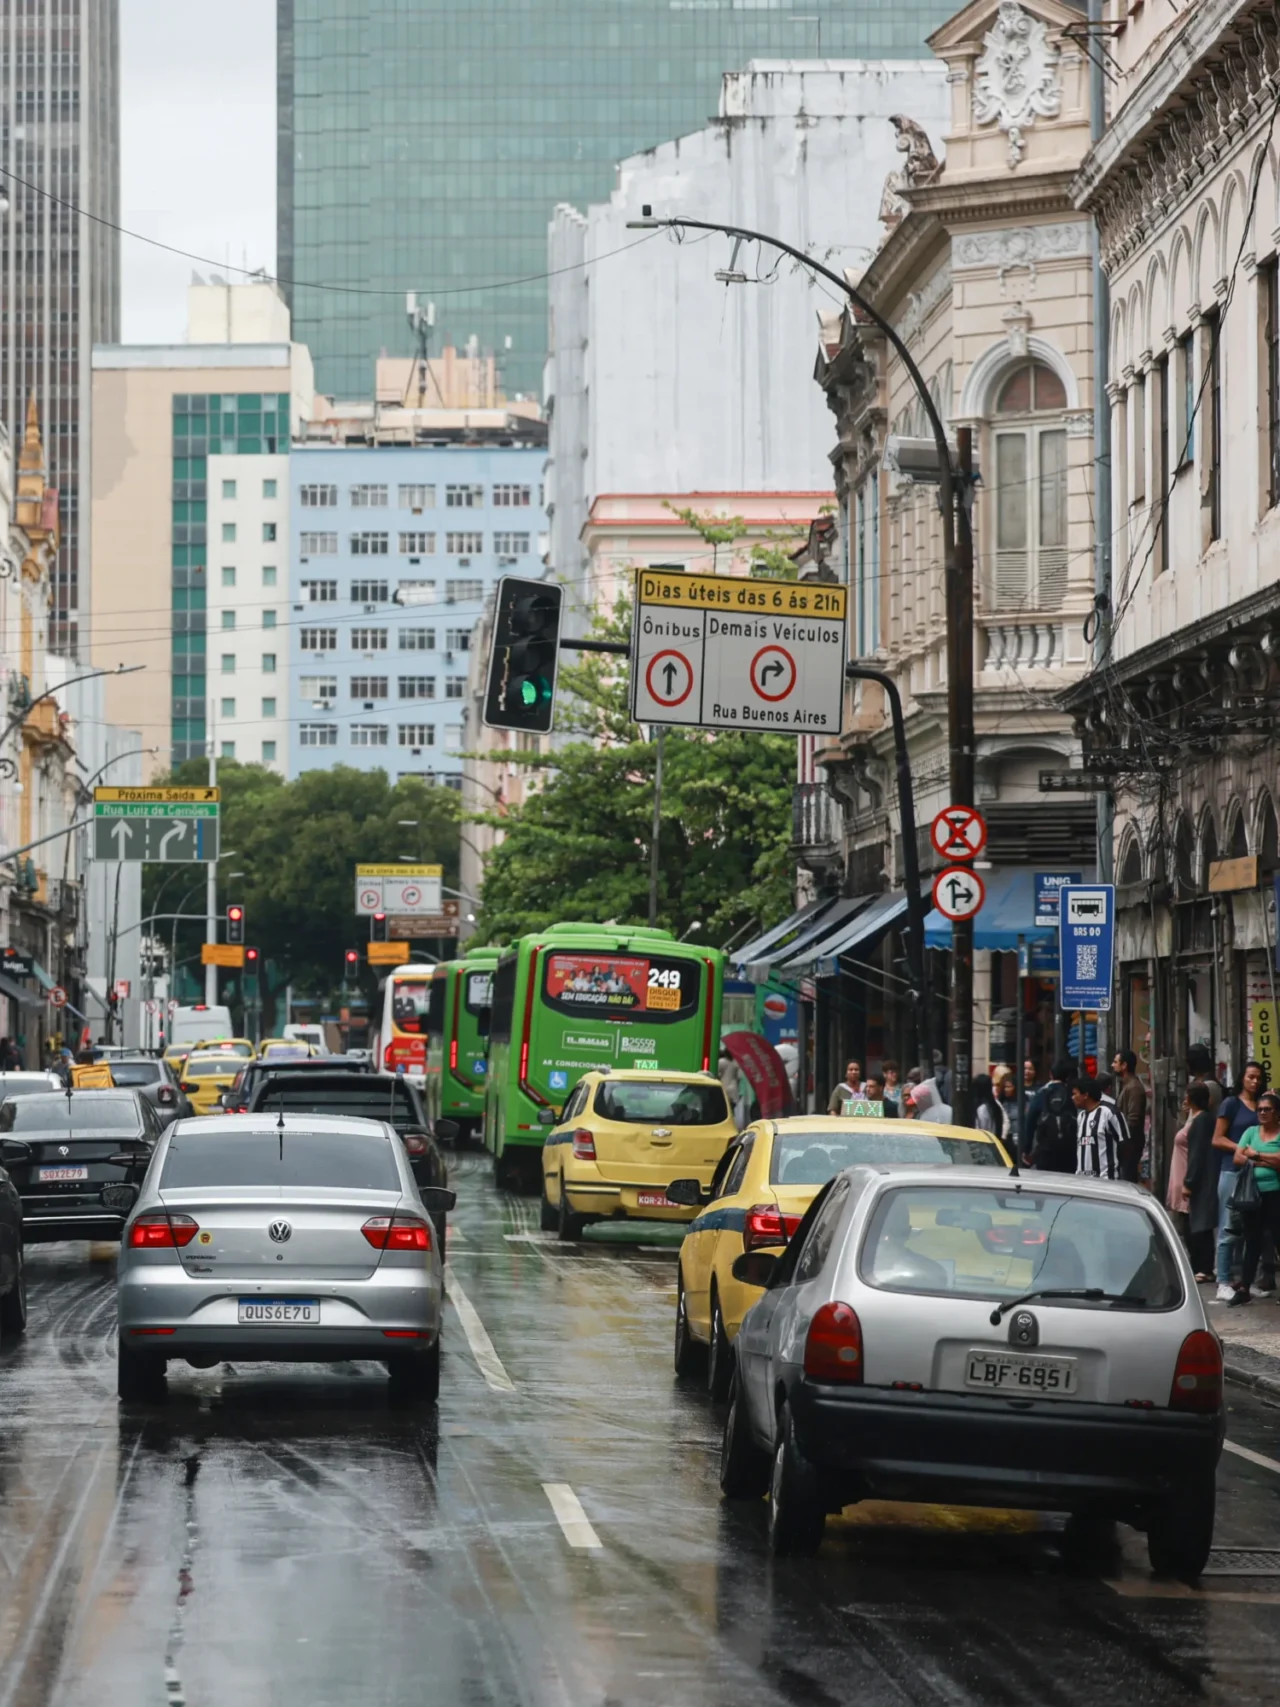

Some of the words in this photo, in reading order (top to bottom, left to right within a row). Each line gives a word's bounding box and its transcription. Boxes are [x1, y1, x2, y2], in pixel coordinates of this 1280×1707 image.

[645, 579, 681, 599] Dias
[688, 582, 731, 603] úteis
[737, 588, 766, 606] das
[772, 590, 783, 607] 6
[814, 594, 840, 612] 21h
[643, 616, 700, 638] Ônibus
[710, 618, 767, 638] Demais
[773, 622, 839, 643] Veículos
[713, 704, 737, 719] Rua
[742, 706, 789, 723] Buenos
[793, 709, 827, 725] Aires
[118, 789, 163, 801] Próxima
[103, 805, 124, 815] Rua
[127, 805, 149, 815] Luiz
[151, 805, 164, 815] de
[1073, 927, 1088, 937] BRS
[647, 967, 681, 990] 249
[635, 1060, 658, 1069] TAXI
[843, 1101, 883, 1117] TAXI
[245, 1305, 312, 1320] QUS6E70
